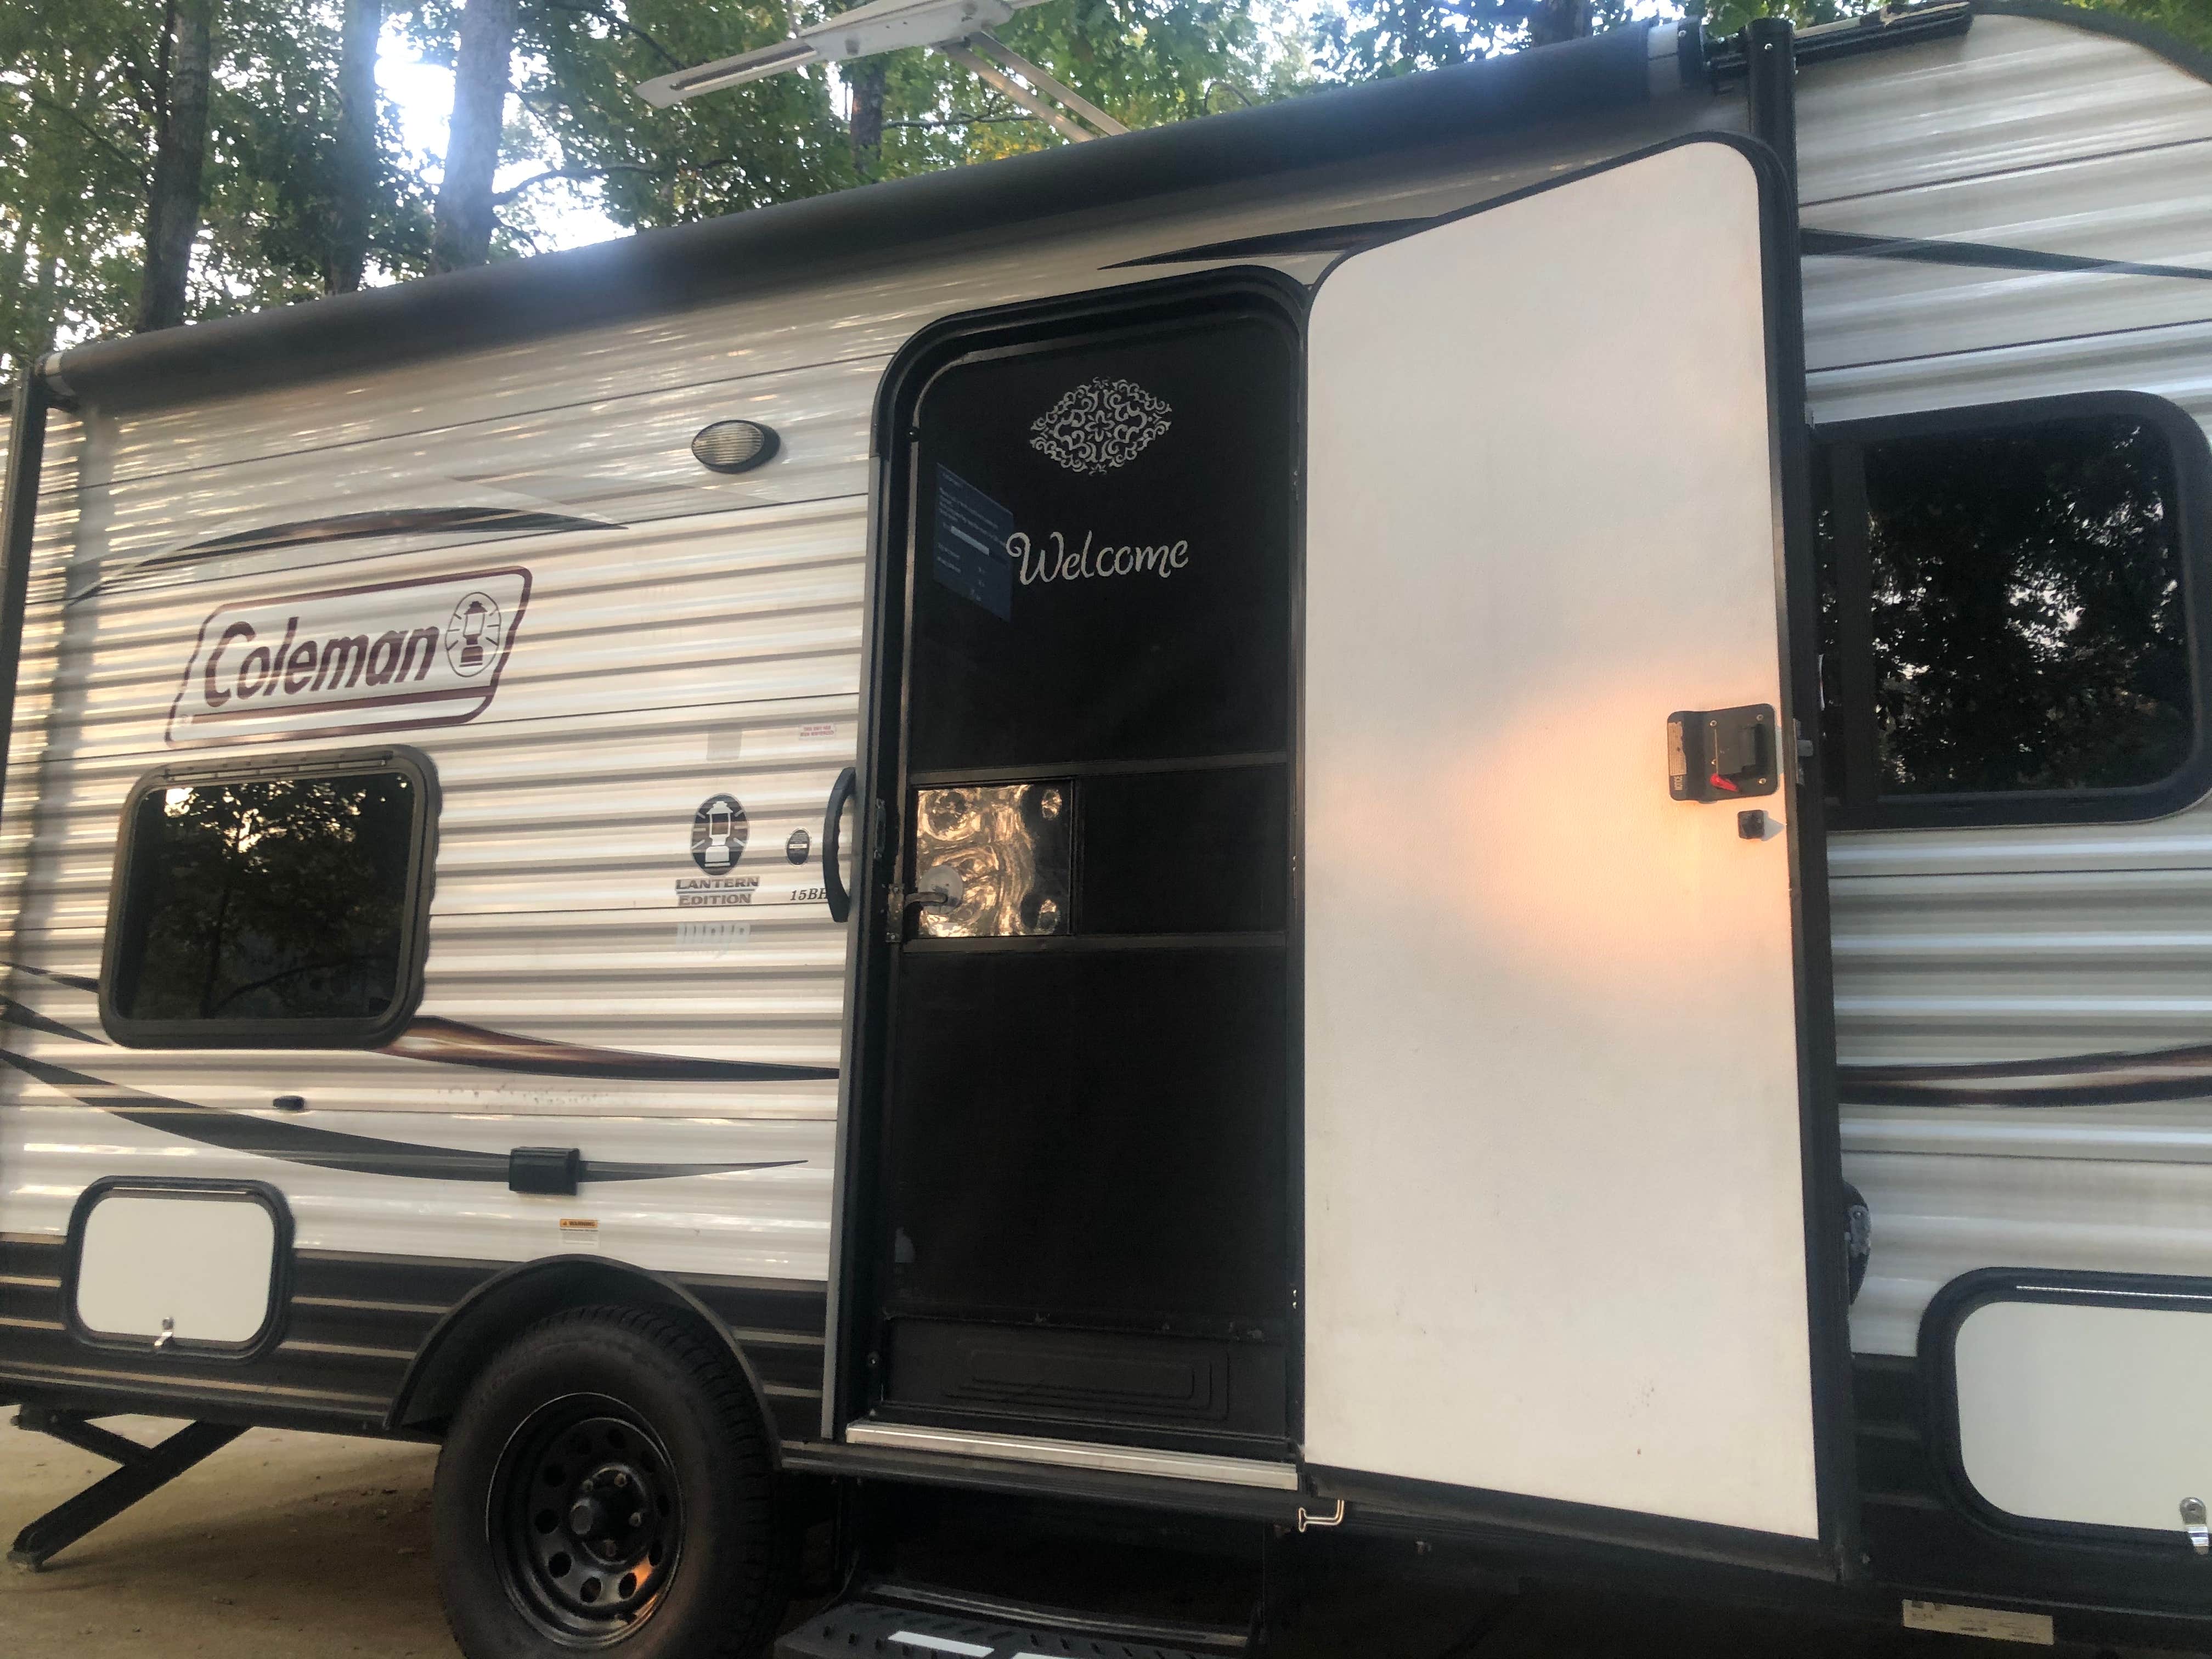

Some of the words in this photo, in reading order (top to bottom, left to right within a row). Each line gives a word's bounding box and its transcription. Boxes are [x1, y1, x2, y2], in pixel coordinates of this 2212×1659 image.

[1006, 530, 1189, 586] Welcome
[204, 617, 440, 708] Coleman
[676, 877, 760, 890] LANTERN
[679, 893, 752, 906] EDITION
